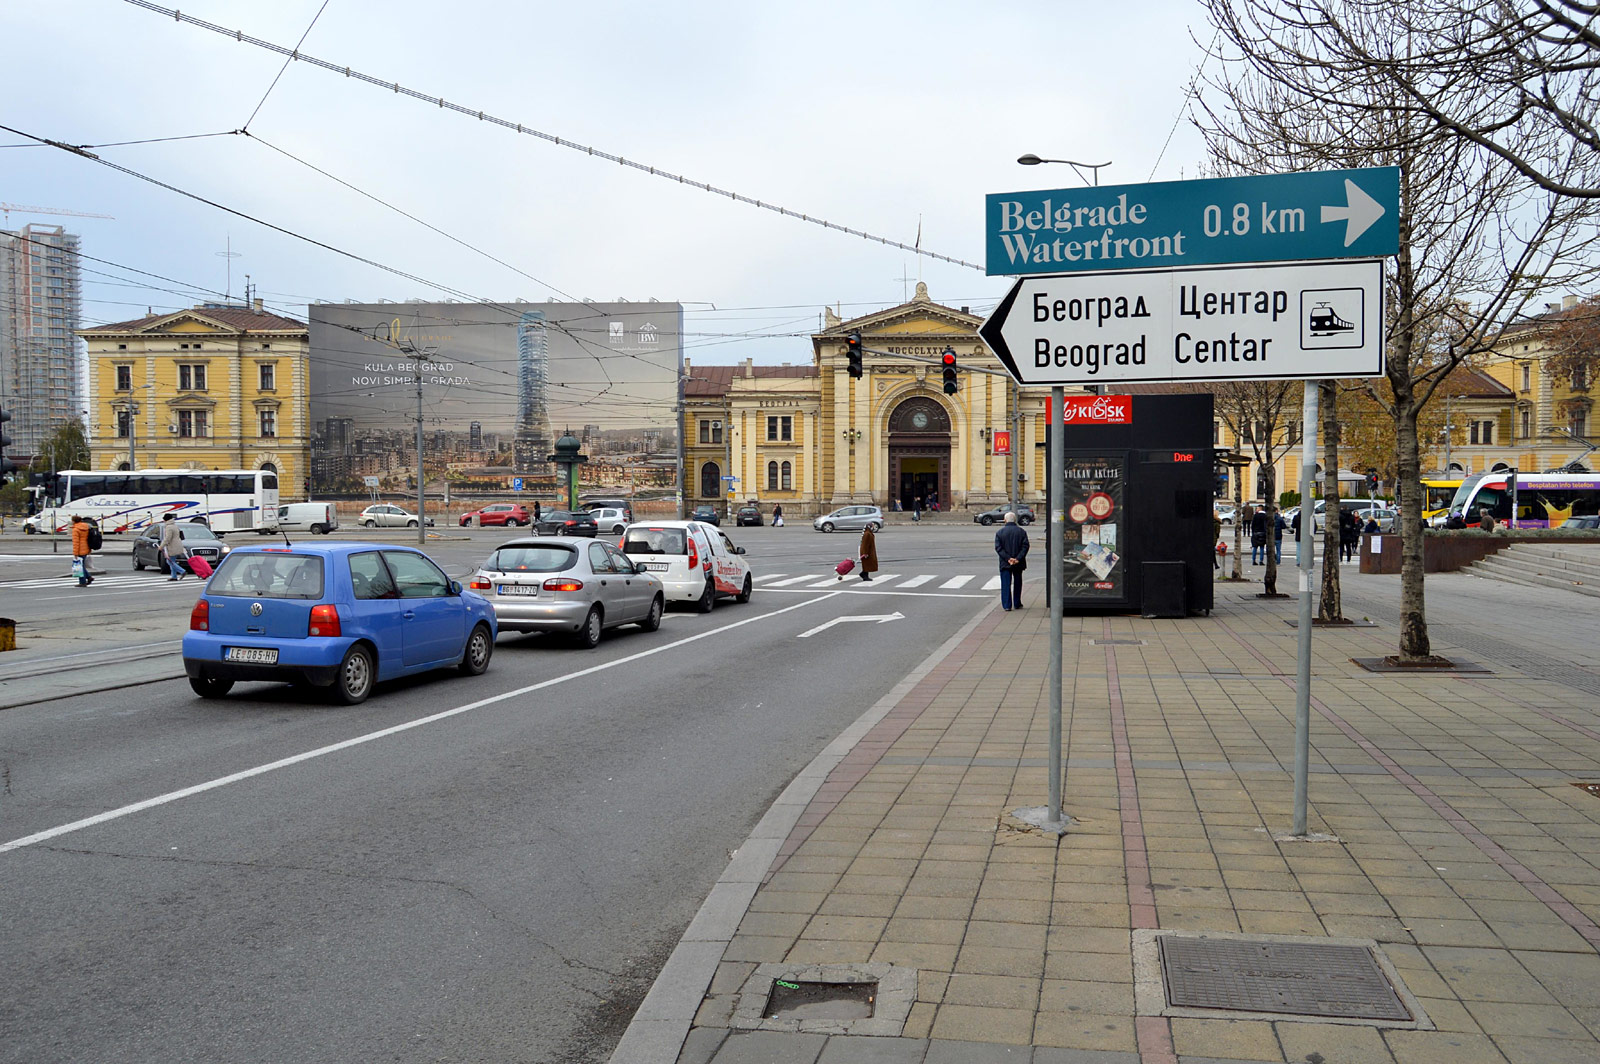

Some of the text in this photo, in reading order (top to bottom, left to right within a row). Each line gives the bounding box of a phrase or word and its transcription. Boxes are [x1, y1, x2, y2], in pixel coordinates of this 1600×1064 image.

[999, 193, 1306, 237] Belgrade 0.8 km
[999, 229, 1186, 265] Waterfront
[1033, 285, 1288, 328] Београд Центар
[887, 346, 943, 355] MDCCCLXXX
[1034, 332, 1273, 374] Beograd Centar
[364, 363, 394, 372] KULA
[352, 376, 380, 385] NOVI
[430, 376, 471, 385] GRADA
[1079, 405, 1125, 418] KIOSK
[230, 648, 242, 659] LE
